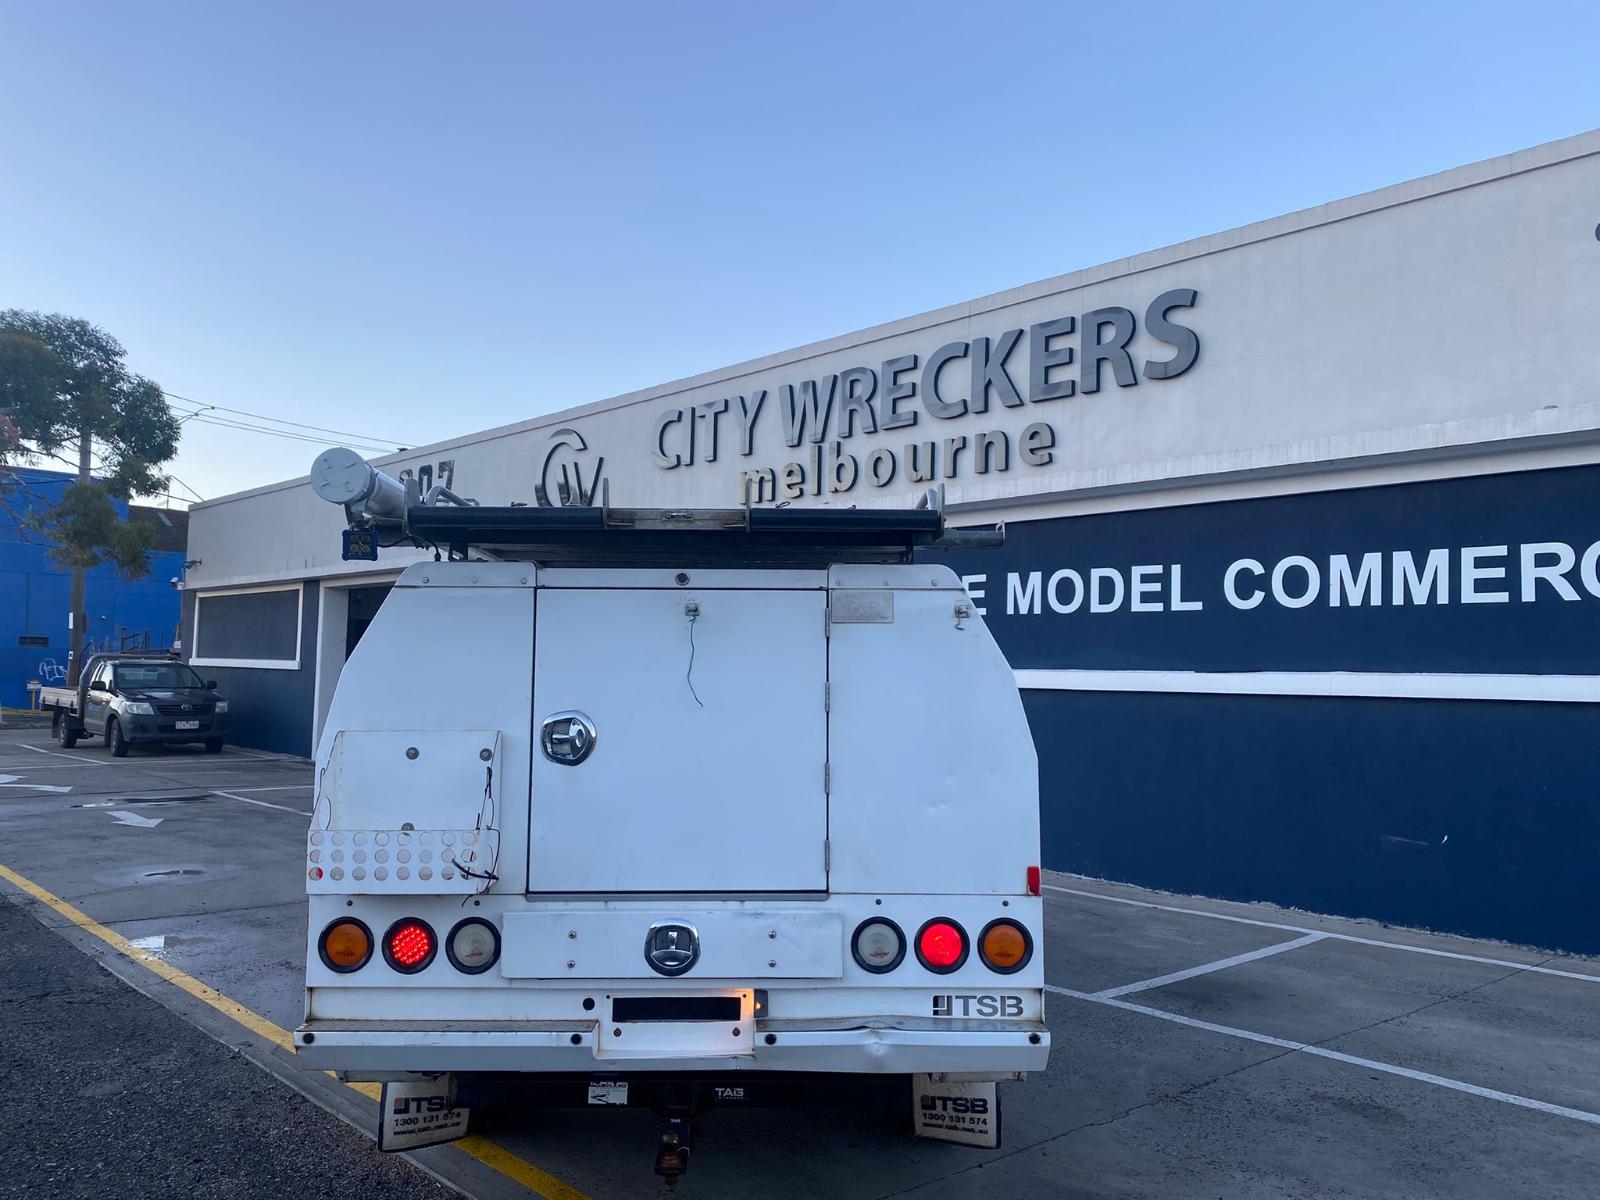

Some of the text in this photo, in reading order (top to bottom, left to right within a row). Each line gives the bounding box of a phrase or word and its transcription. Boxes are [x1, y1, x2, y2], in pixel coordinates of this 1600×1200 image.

[651, 288, 1200, 470] CITY WRECKERS
[739, 421, 1056, 505] melbourne
[1006, 563, 1203, 615] MODEL
[715, 1087, 744, 1097] TAG
[922, 1112, 988, 1126] 1300 131 574
